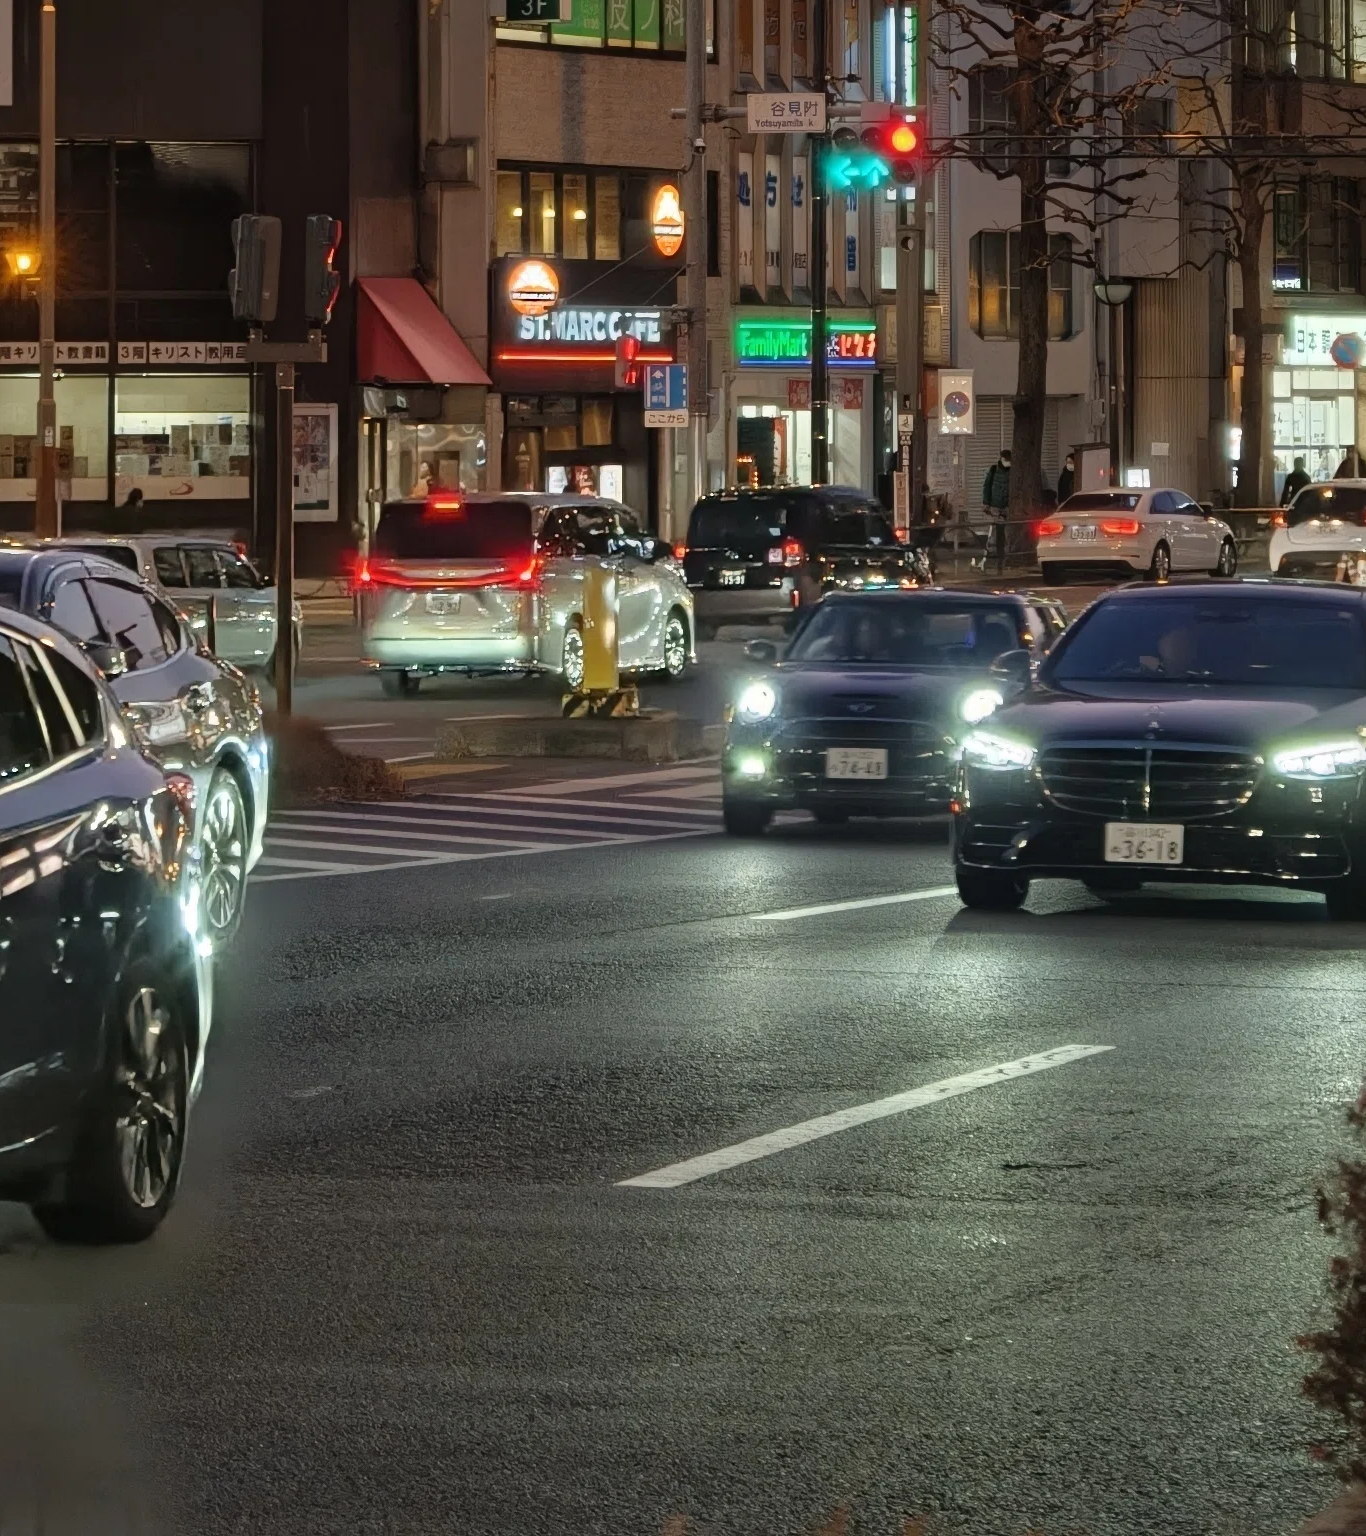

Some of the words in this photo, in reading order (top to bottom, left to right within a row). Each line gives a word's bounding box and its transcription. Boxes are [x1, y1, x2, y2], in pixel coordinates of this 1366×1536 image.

[759, 101, 819, 117] 谷見附
[741, 330, 808, 360] FamilyMart
[647, 415, 686, 425] ここから
